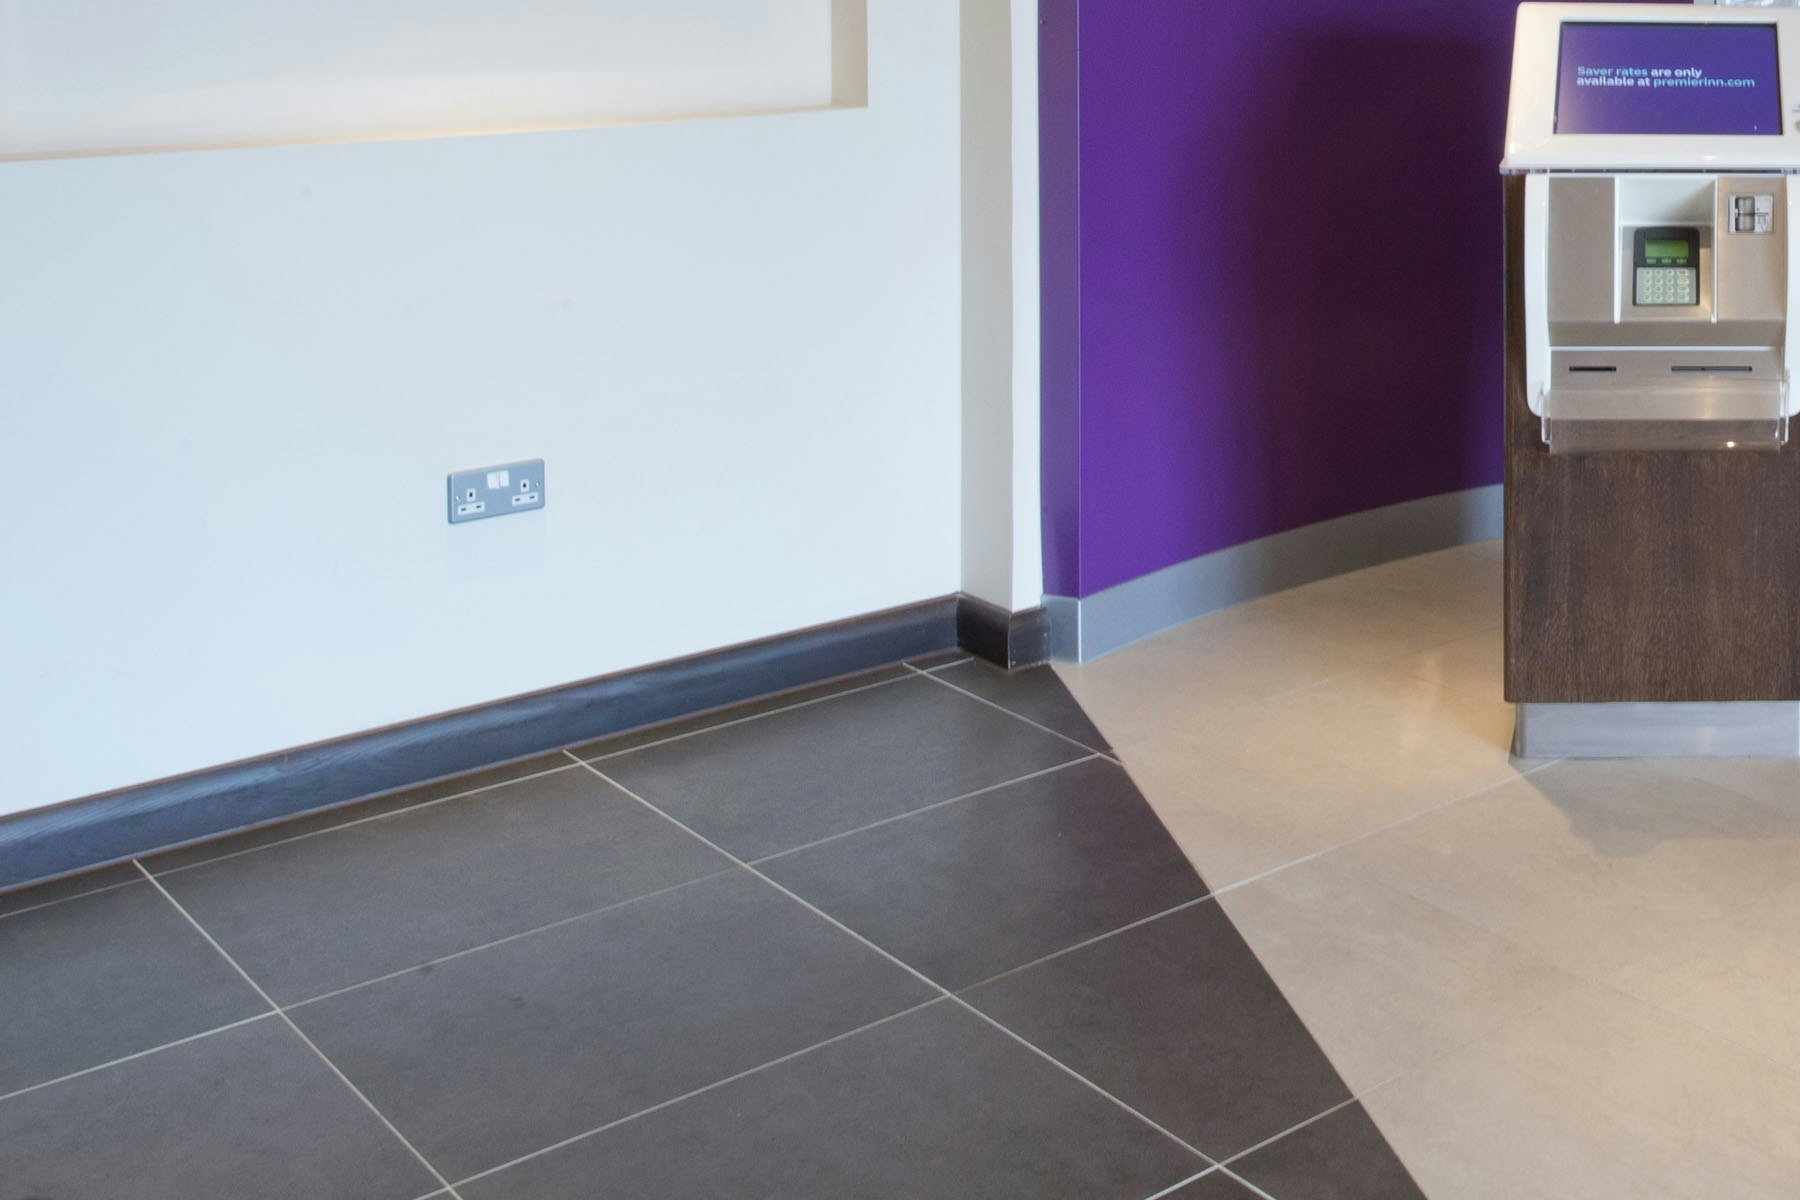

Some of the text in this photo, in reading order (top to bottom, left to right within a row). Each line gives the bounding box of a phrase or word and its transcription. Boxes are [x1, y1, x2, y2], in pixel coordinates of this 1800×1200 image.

[1577, 66, 1702, 79] Saver rates are only
[1577, 76, 1755, 88] available at premierinn.com
